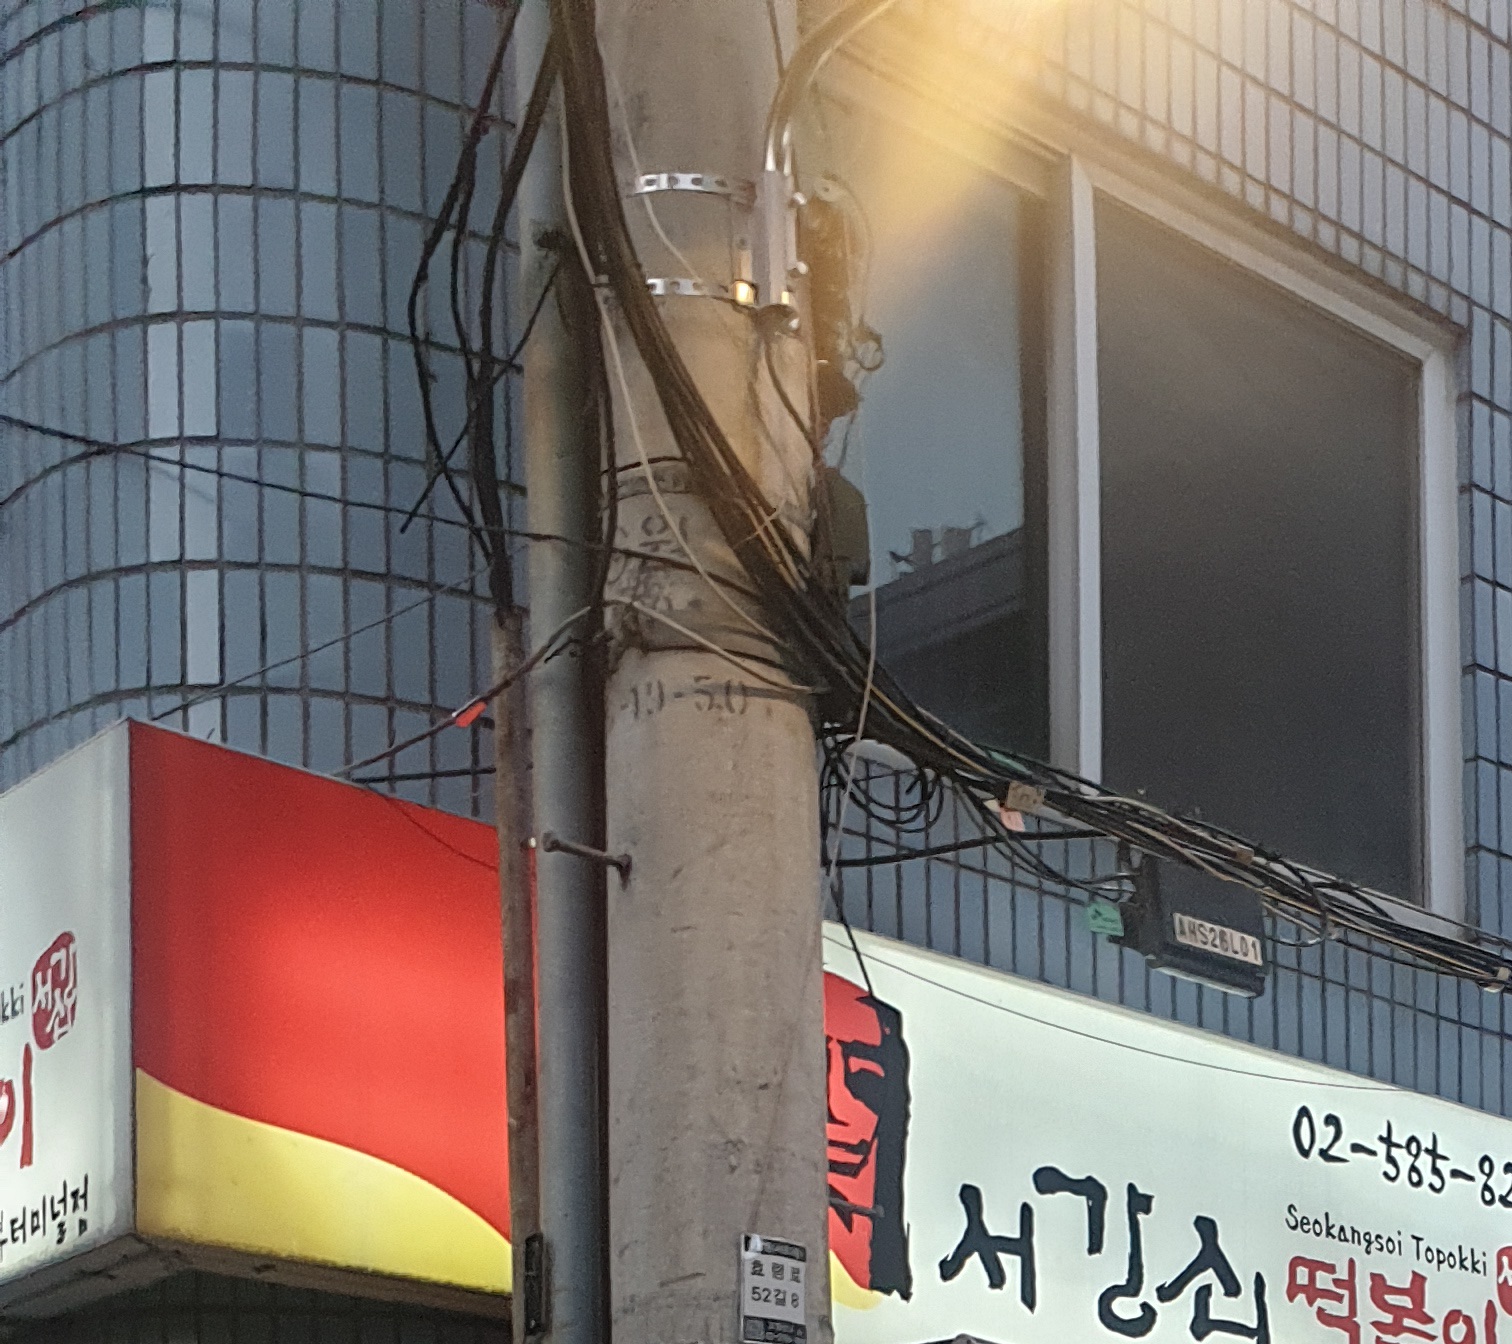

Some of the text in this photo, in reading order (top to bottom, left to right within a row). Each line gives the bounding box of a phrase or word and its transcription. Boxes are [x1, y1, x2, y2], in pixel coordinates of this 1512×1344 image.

[0, 1172, 89, 1262] 터미널점
[1285, 1203, 1489, 1278] Seokangsoi Topokki
